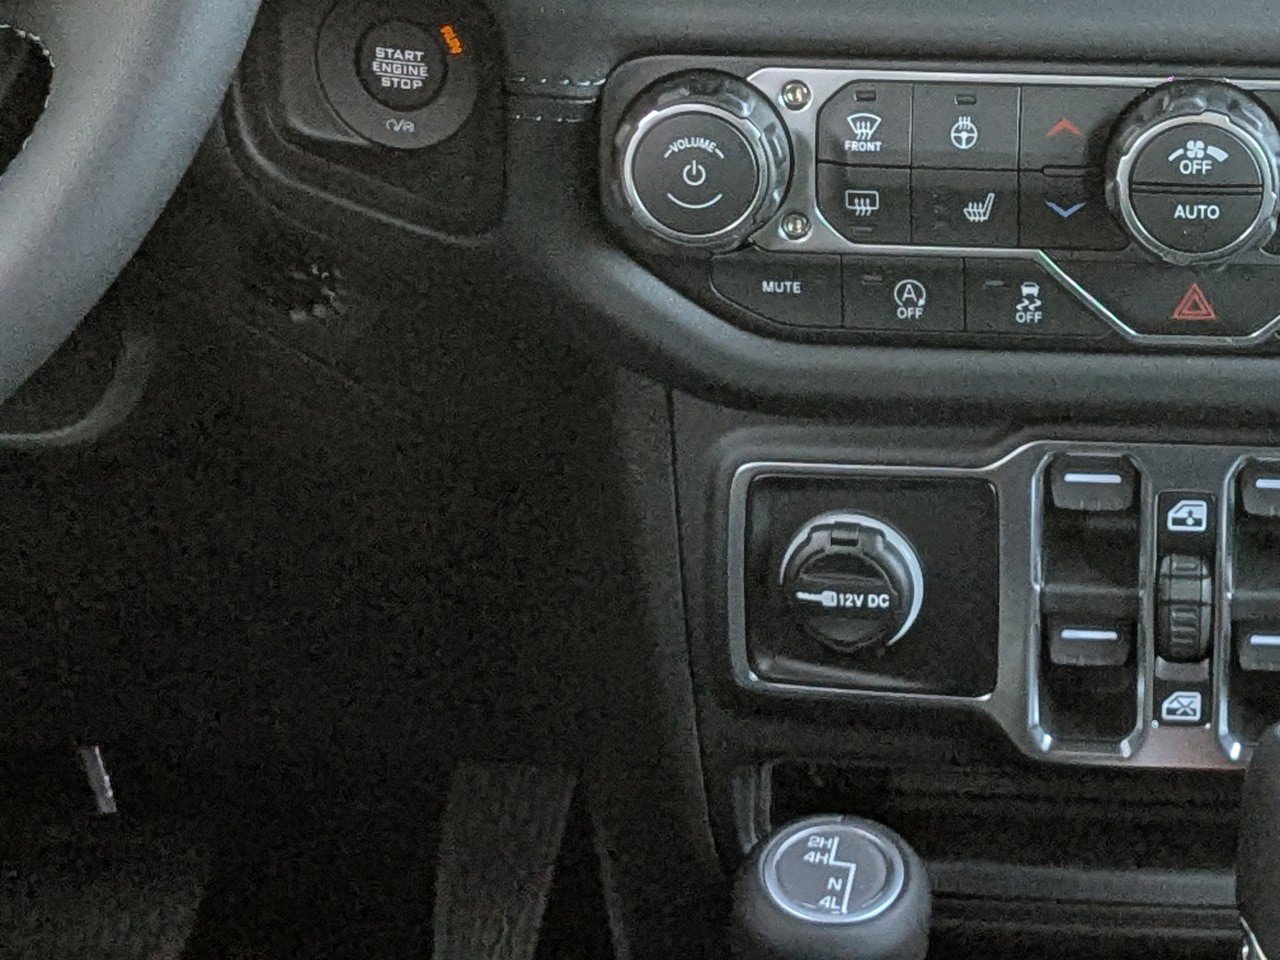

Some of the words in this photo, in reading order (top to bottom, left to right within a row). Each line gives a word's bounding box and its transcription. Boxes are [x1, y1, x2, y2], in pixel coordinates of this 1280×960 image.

[375, 46, 424, 62] START
[372, 61, 429, 77] ENGINE
[381, 77, 423, 90] STOP
[669, 137, 718, 153] VOLUME
[844, 141, 882, 152] FRONT
[1179, 159, 1213, 175] OFF
[1173, 204, 1221, 221] AUTO
[762, 280, 802, 294] MUTE
[896, 306, 924, 320] OFF
[1015, 310, 1043, 324] OFF
[838, 592, 864, 608] 12V
[868, 593, 890, 608] DC
[808, 835, 833, 849] 2H
[803, 851, 830, 865] 4H
[827, 876, 842, 891] N
[819, 895, 841, 910] 4L
